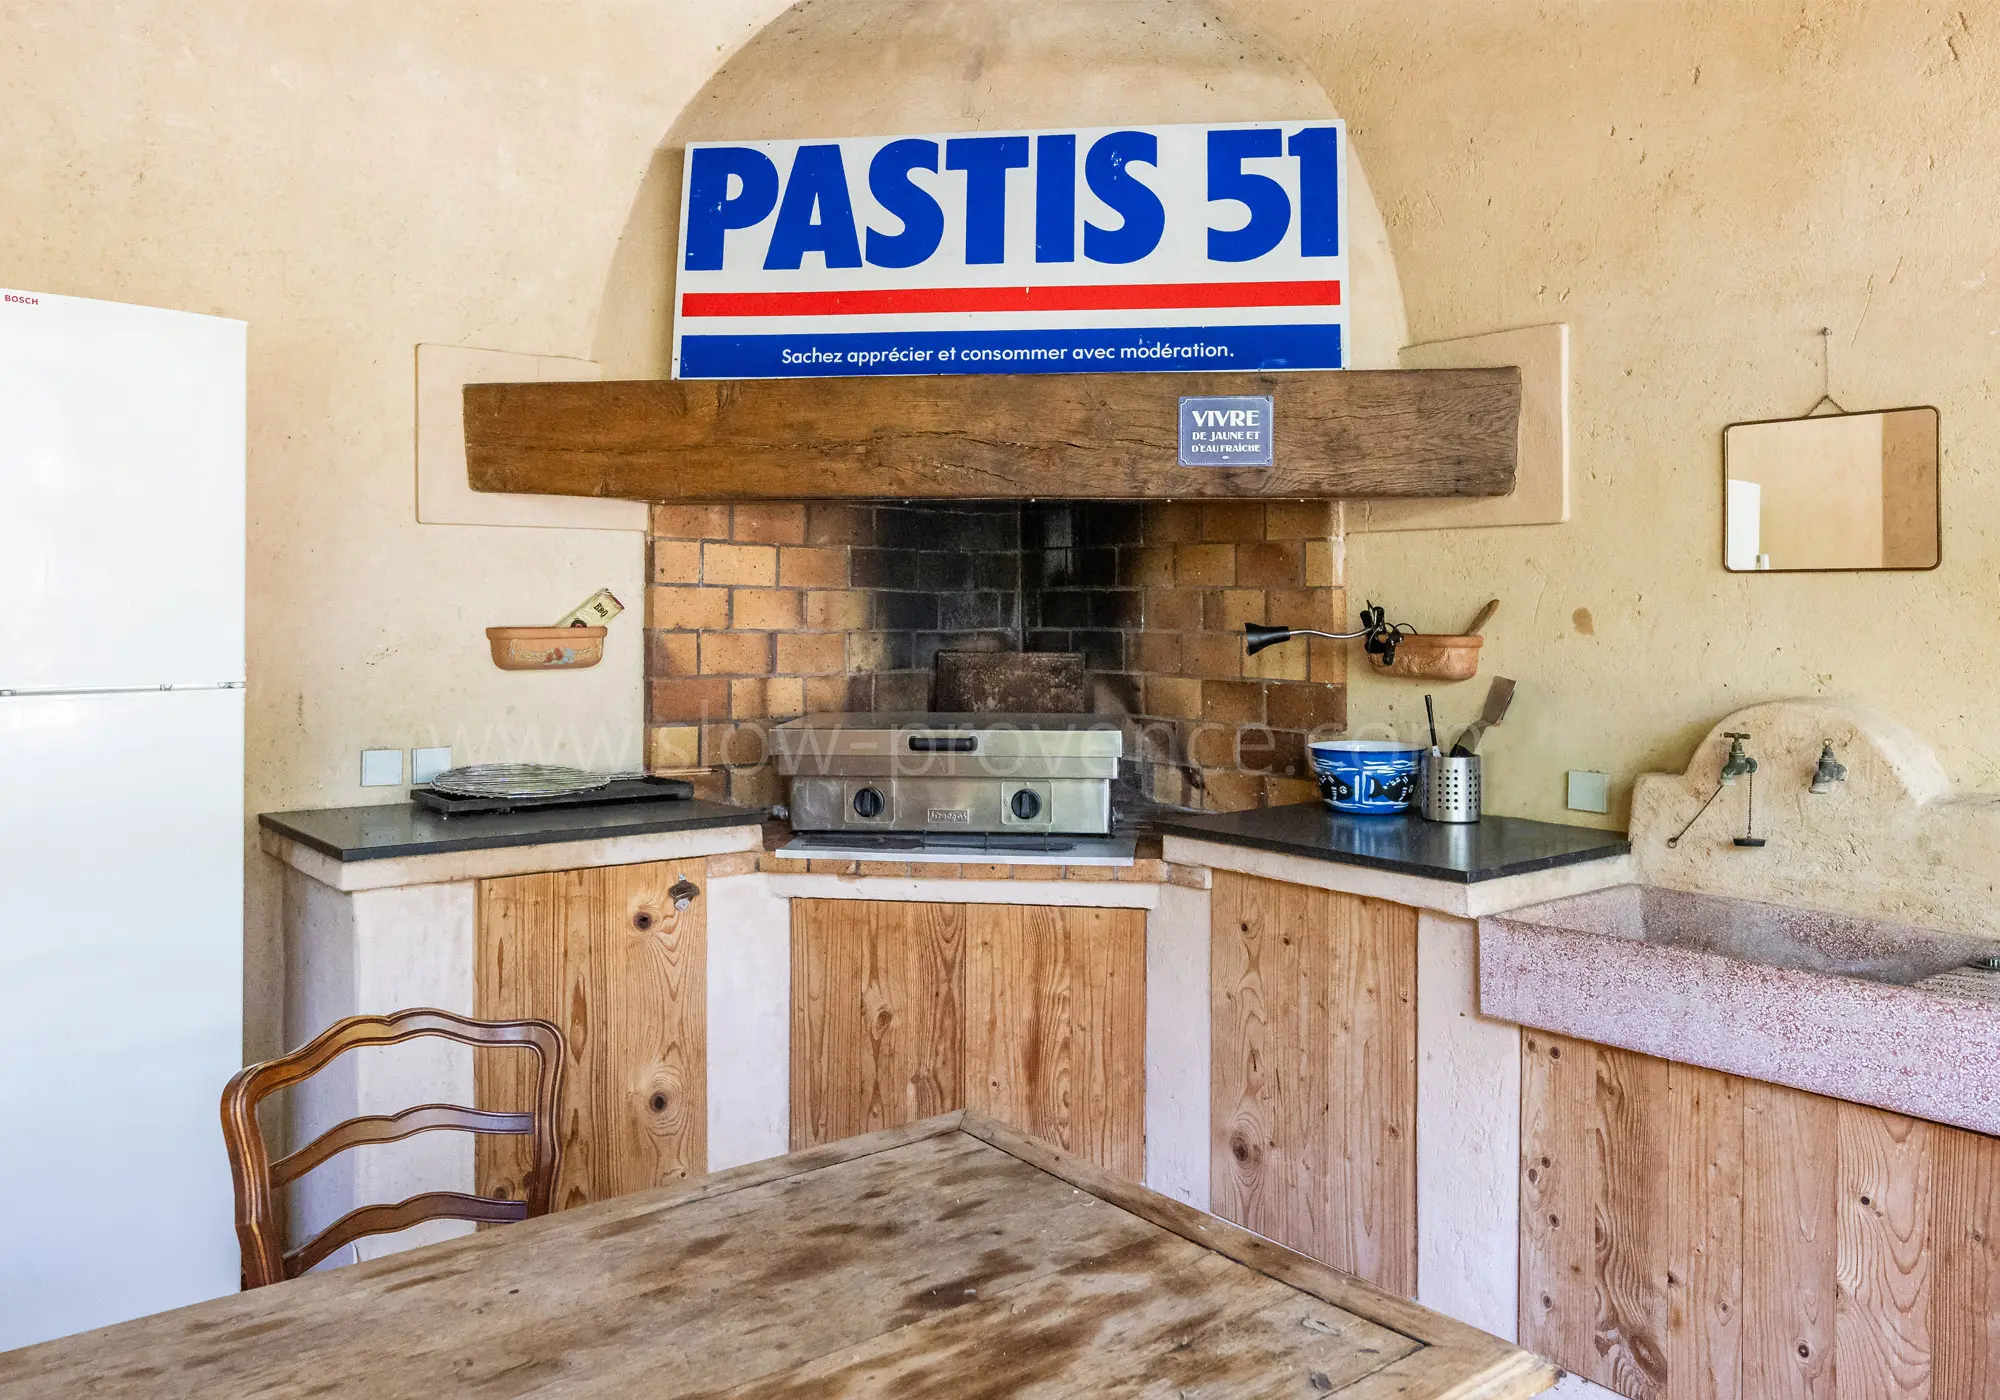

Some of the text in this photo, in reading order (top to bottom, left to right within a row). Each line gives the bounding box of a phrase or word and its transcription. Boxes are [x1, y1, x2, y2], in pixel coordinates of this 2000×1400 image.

[685, 126, 1340, 271] PASTIS 51
[4, 294, 39, 305] BOSCH
[781, 341, 1235, 366] Sachez apprécier et consommer avec modération.
[1191, 410, 1260, 427] VIVRE
[1192, 431, 1260, 441] DE JAUNE ET
[1191, 443, 1219, 453] D'EAU
[593, 602, 608, 618] BBQ
